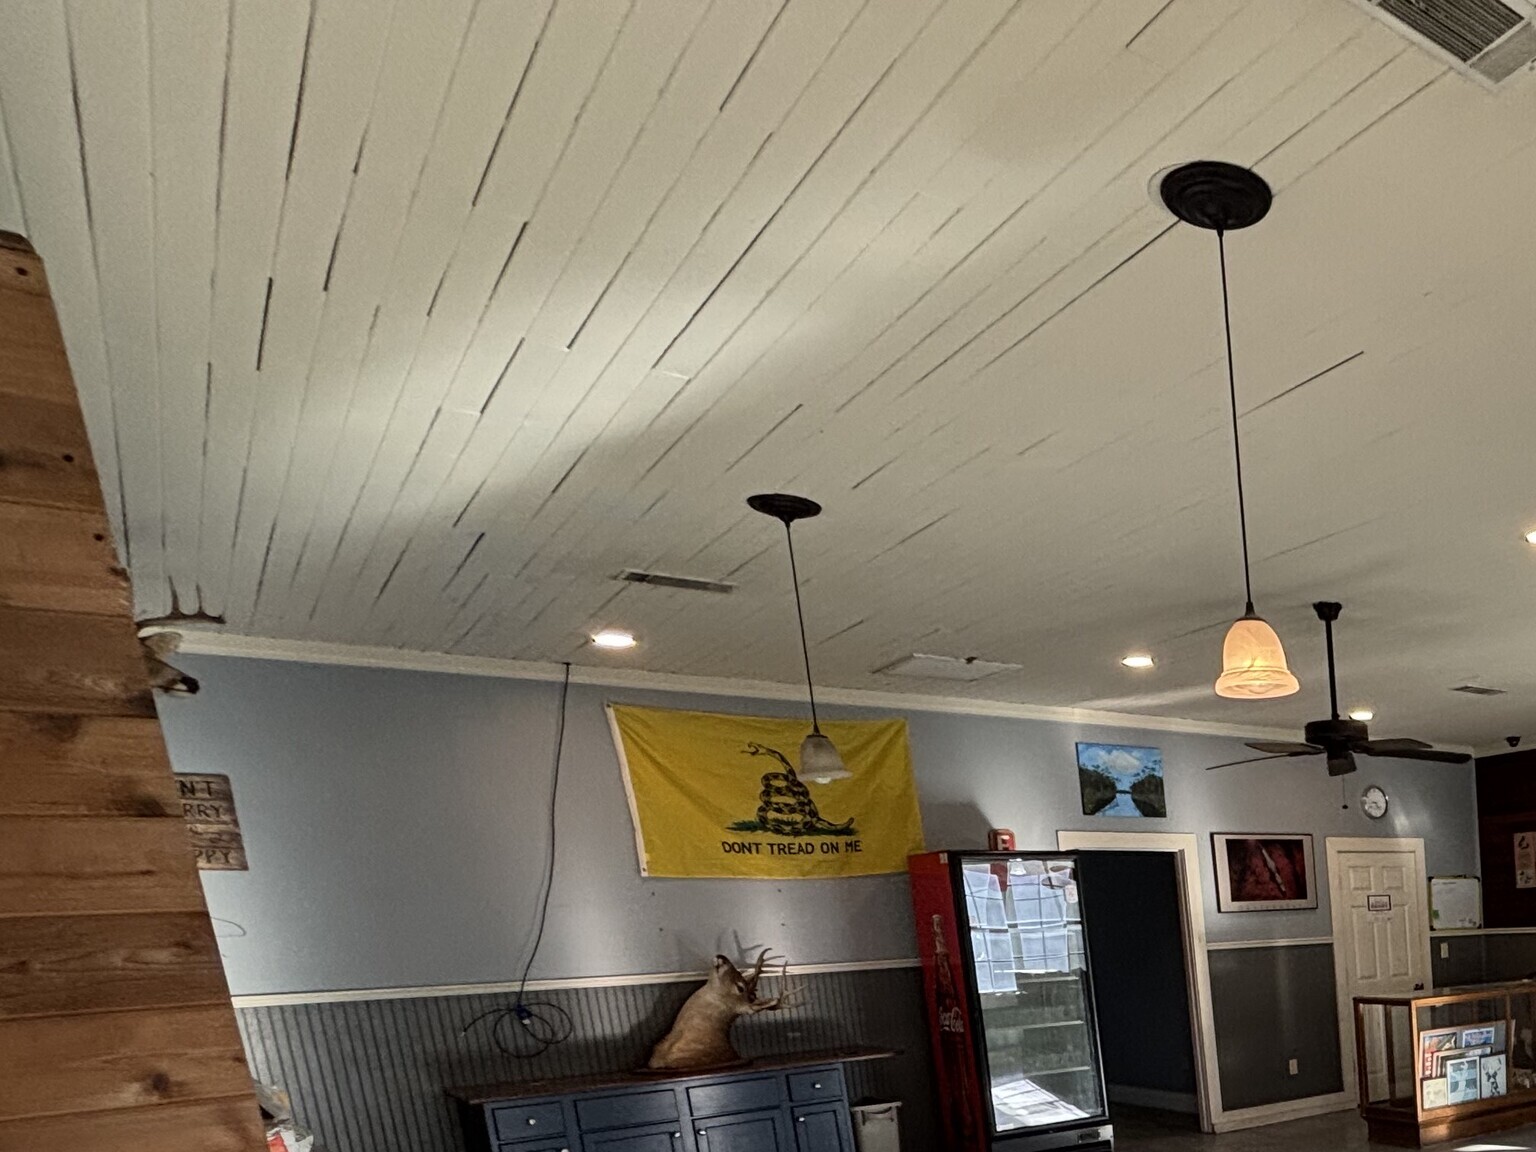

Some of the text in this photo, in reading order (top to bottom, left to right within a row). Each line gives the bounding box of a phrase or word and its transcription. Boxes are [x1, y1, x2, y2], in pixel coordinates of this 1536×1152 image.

[721, 840, 862, 855] DONT TREAD ON ME
